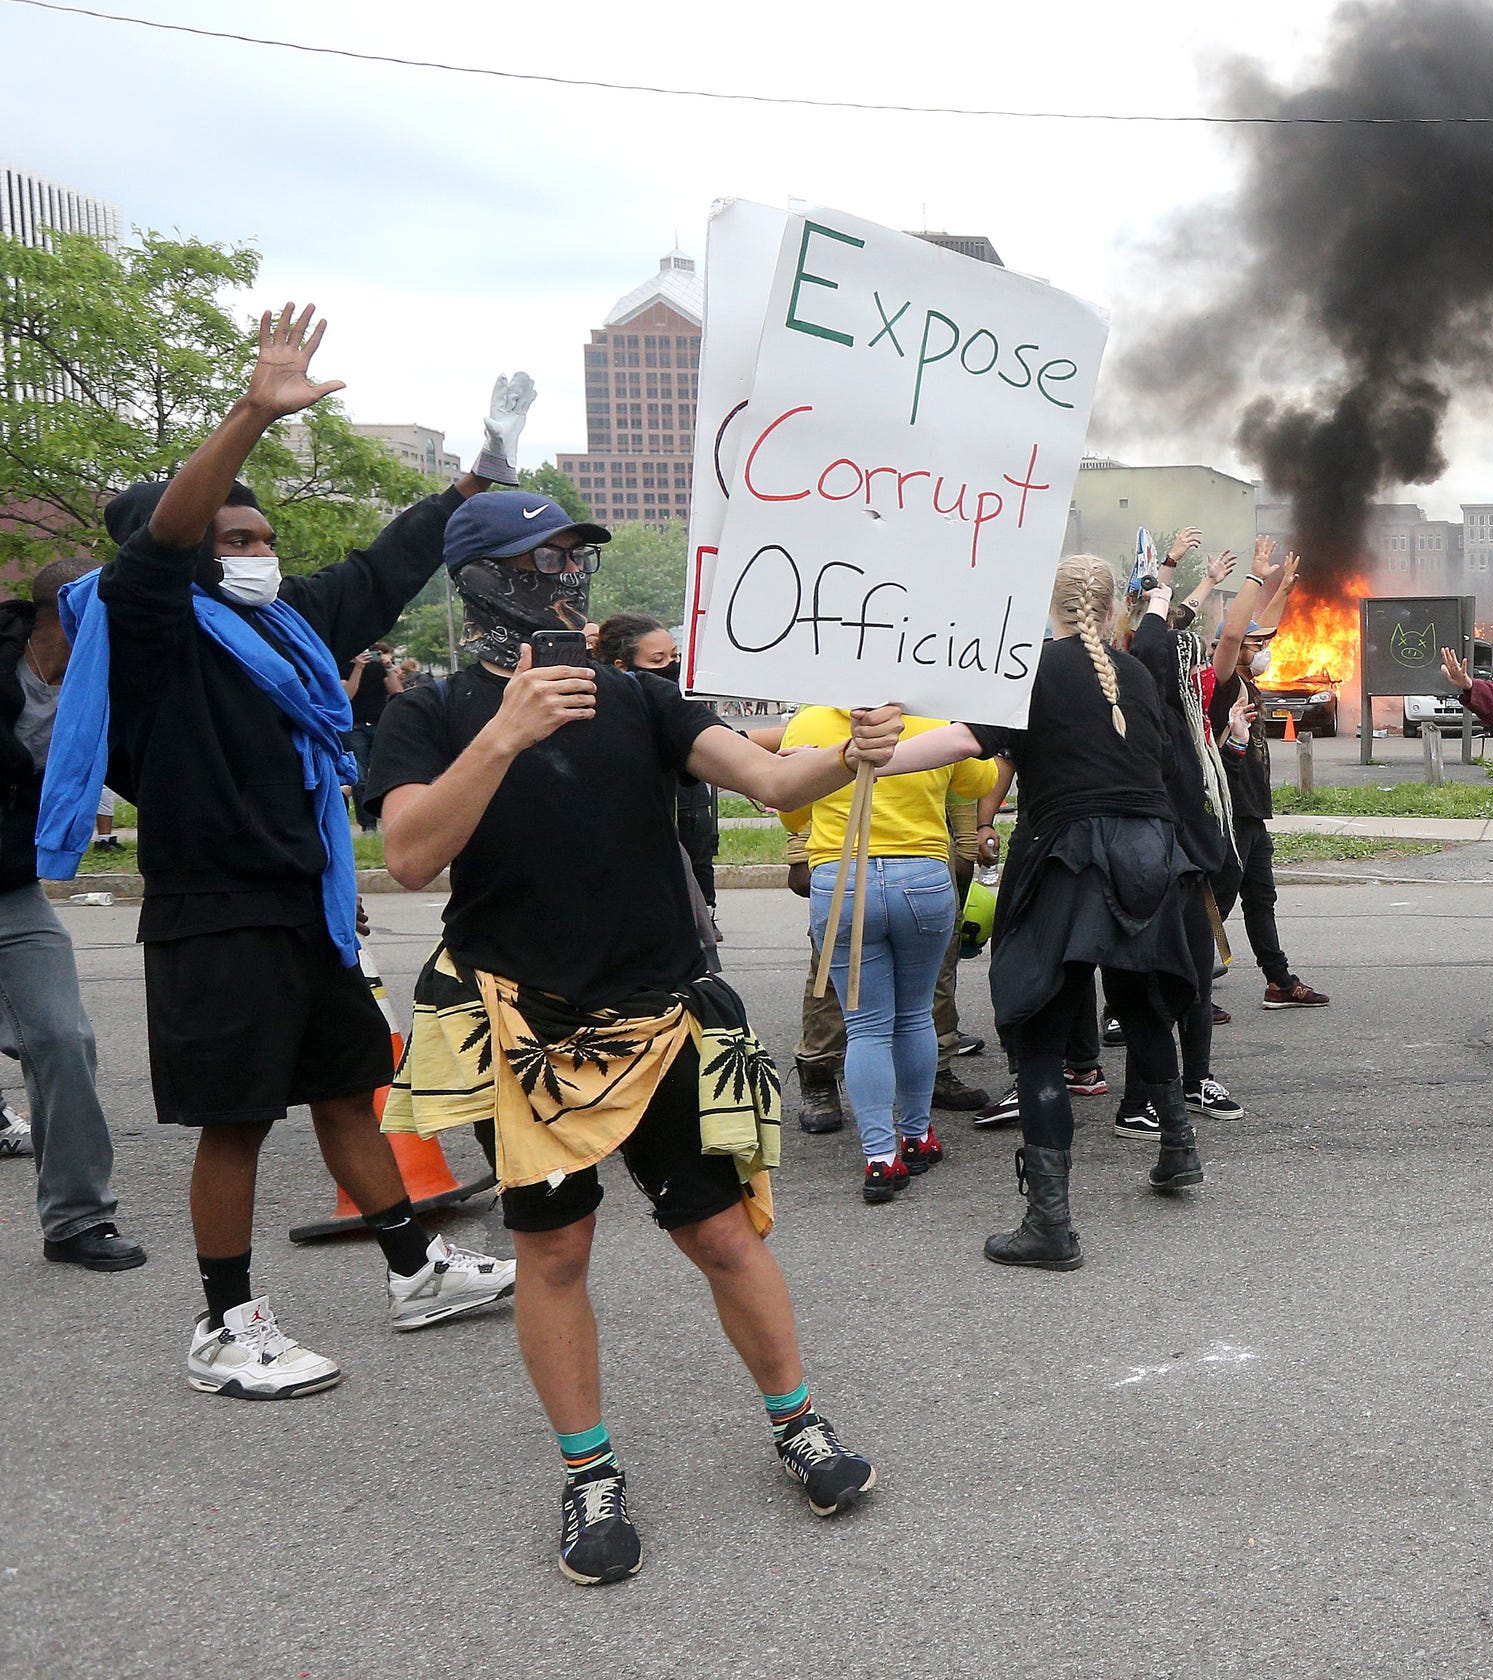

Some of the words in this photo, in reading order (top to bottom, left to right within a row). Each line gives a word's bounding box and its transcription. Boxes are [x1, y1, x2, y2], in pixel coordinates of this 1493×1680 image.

[785, 219, 1078, 425] Expose
[745, 405, 1050, 568] Corrupt
[726, 544, 1033, 680] Officials
